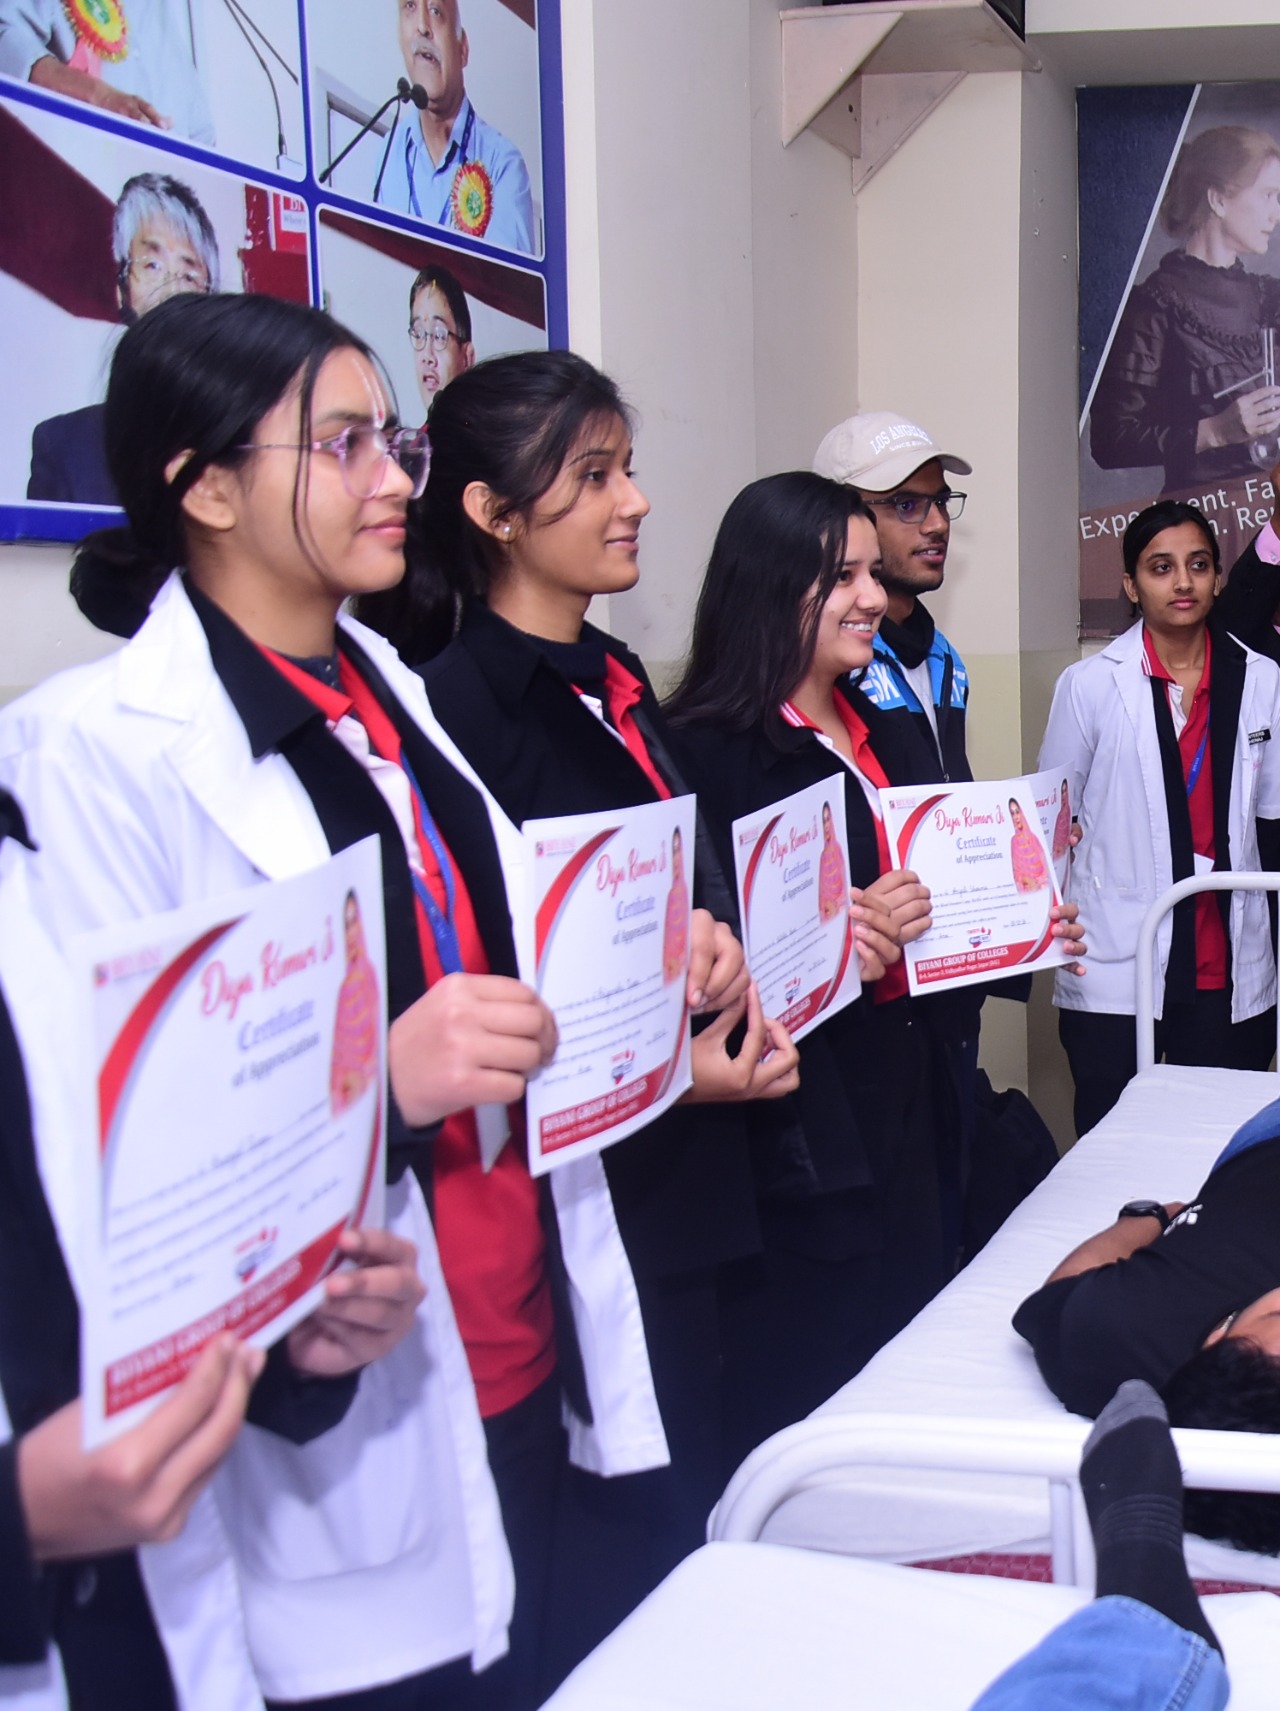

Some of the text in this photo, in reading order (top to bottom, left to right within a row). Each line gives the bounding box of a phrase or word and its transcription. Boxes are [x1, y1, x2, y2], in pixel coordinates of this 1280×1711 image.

[870, 431, 890, 455] LOS
[1245, 478, 1275, 502] Fa
[934, 808, 961, 836] Diya
[962, 806, 993, 828] Kumari
[956, 836, 997, 850] Certificate
[956, 851, 1004, 864] of Appreciation
[917, 946, 1009, 972] BIYANI GROUP OF COLLEGES
[576, 1097, 606, 1120] GROUP
